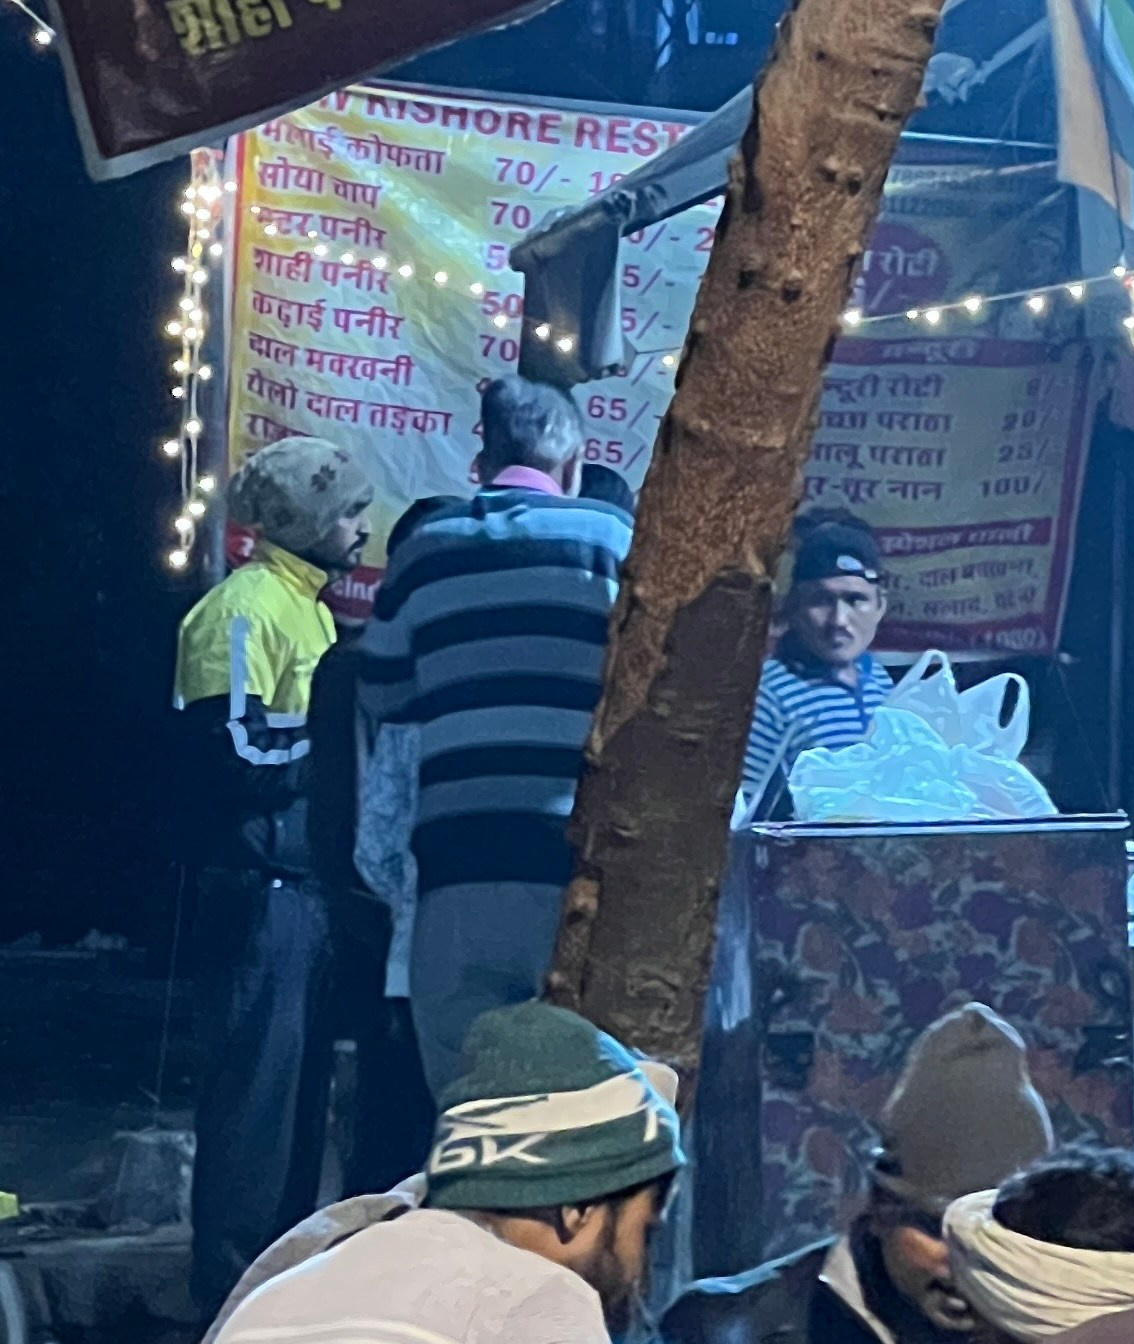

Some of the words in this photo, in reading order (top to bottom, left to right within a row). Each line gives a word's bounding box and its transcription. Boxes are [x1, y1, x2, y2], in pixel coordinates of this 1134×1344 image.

[366, 93, 563, 146] KISHORE
[257, 156, 325, 194] सोया
[331, 175, 383, 209] चाप
[494, 156, 572, 193] 70/-
[319, 215, 388, 250] पनीर
[252, 246, 313, 284] शाही
[319, 257, 392, 295] पनीर
[878, 245, 940, 277] रोटी
[332, 305, 406, 340] पनीर
[248, 330, 299, 367] दाल
[823, 372, 880, 404] न्दूरी
[887, 372, 945, 399] रोटी
[304, 390, 364, 424] दाल
[887, 479, 944, 501] नान
